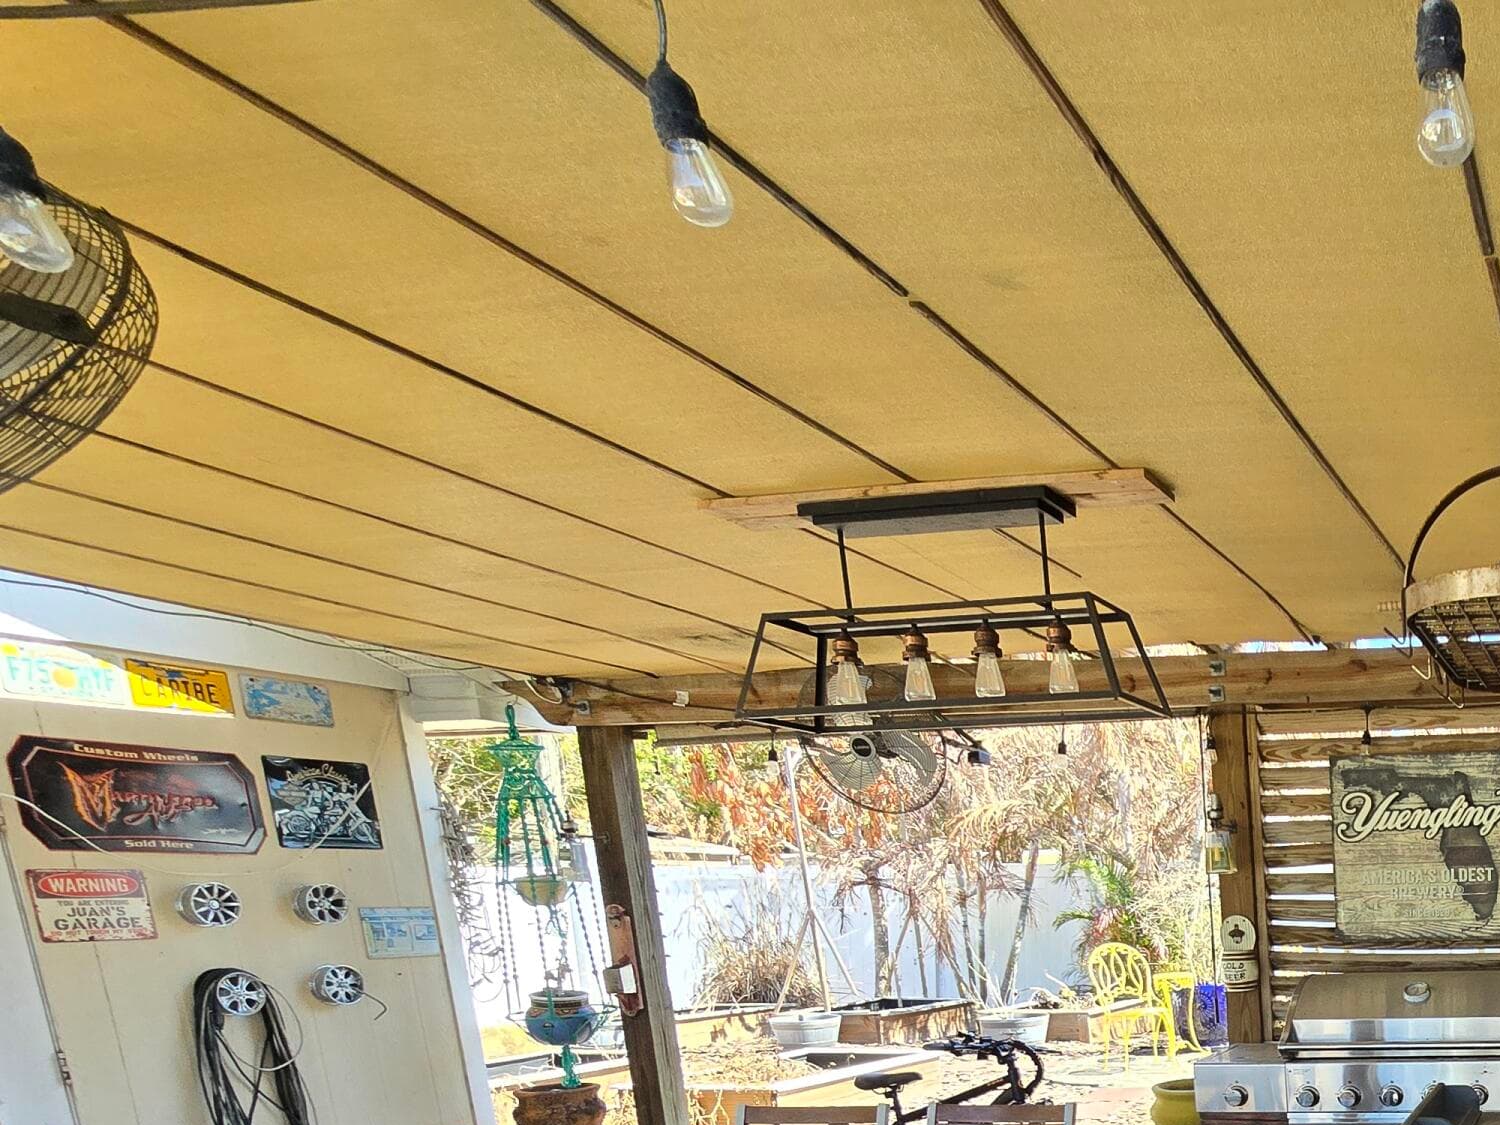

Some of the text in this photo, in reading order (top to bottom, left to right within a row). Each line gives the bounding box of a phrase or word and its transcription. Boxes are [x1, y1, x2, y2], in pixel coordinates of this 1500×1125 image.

[140, 671, 220, 705] CARIBE
[73, 743, 199, 762] Custom Wheels
[125, 839, 194, 850] Sold Here
[1361, 867, 1494, 885] AMERICA'S OLDEST
[47, 878, 130, 893] WARNING
[67, 906, 126, 917] JUAN'S
[54, 917, 143, 930] GARAGE
[1223, 962, 1245, 970] COLD
